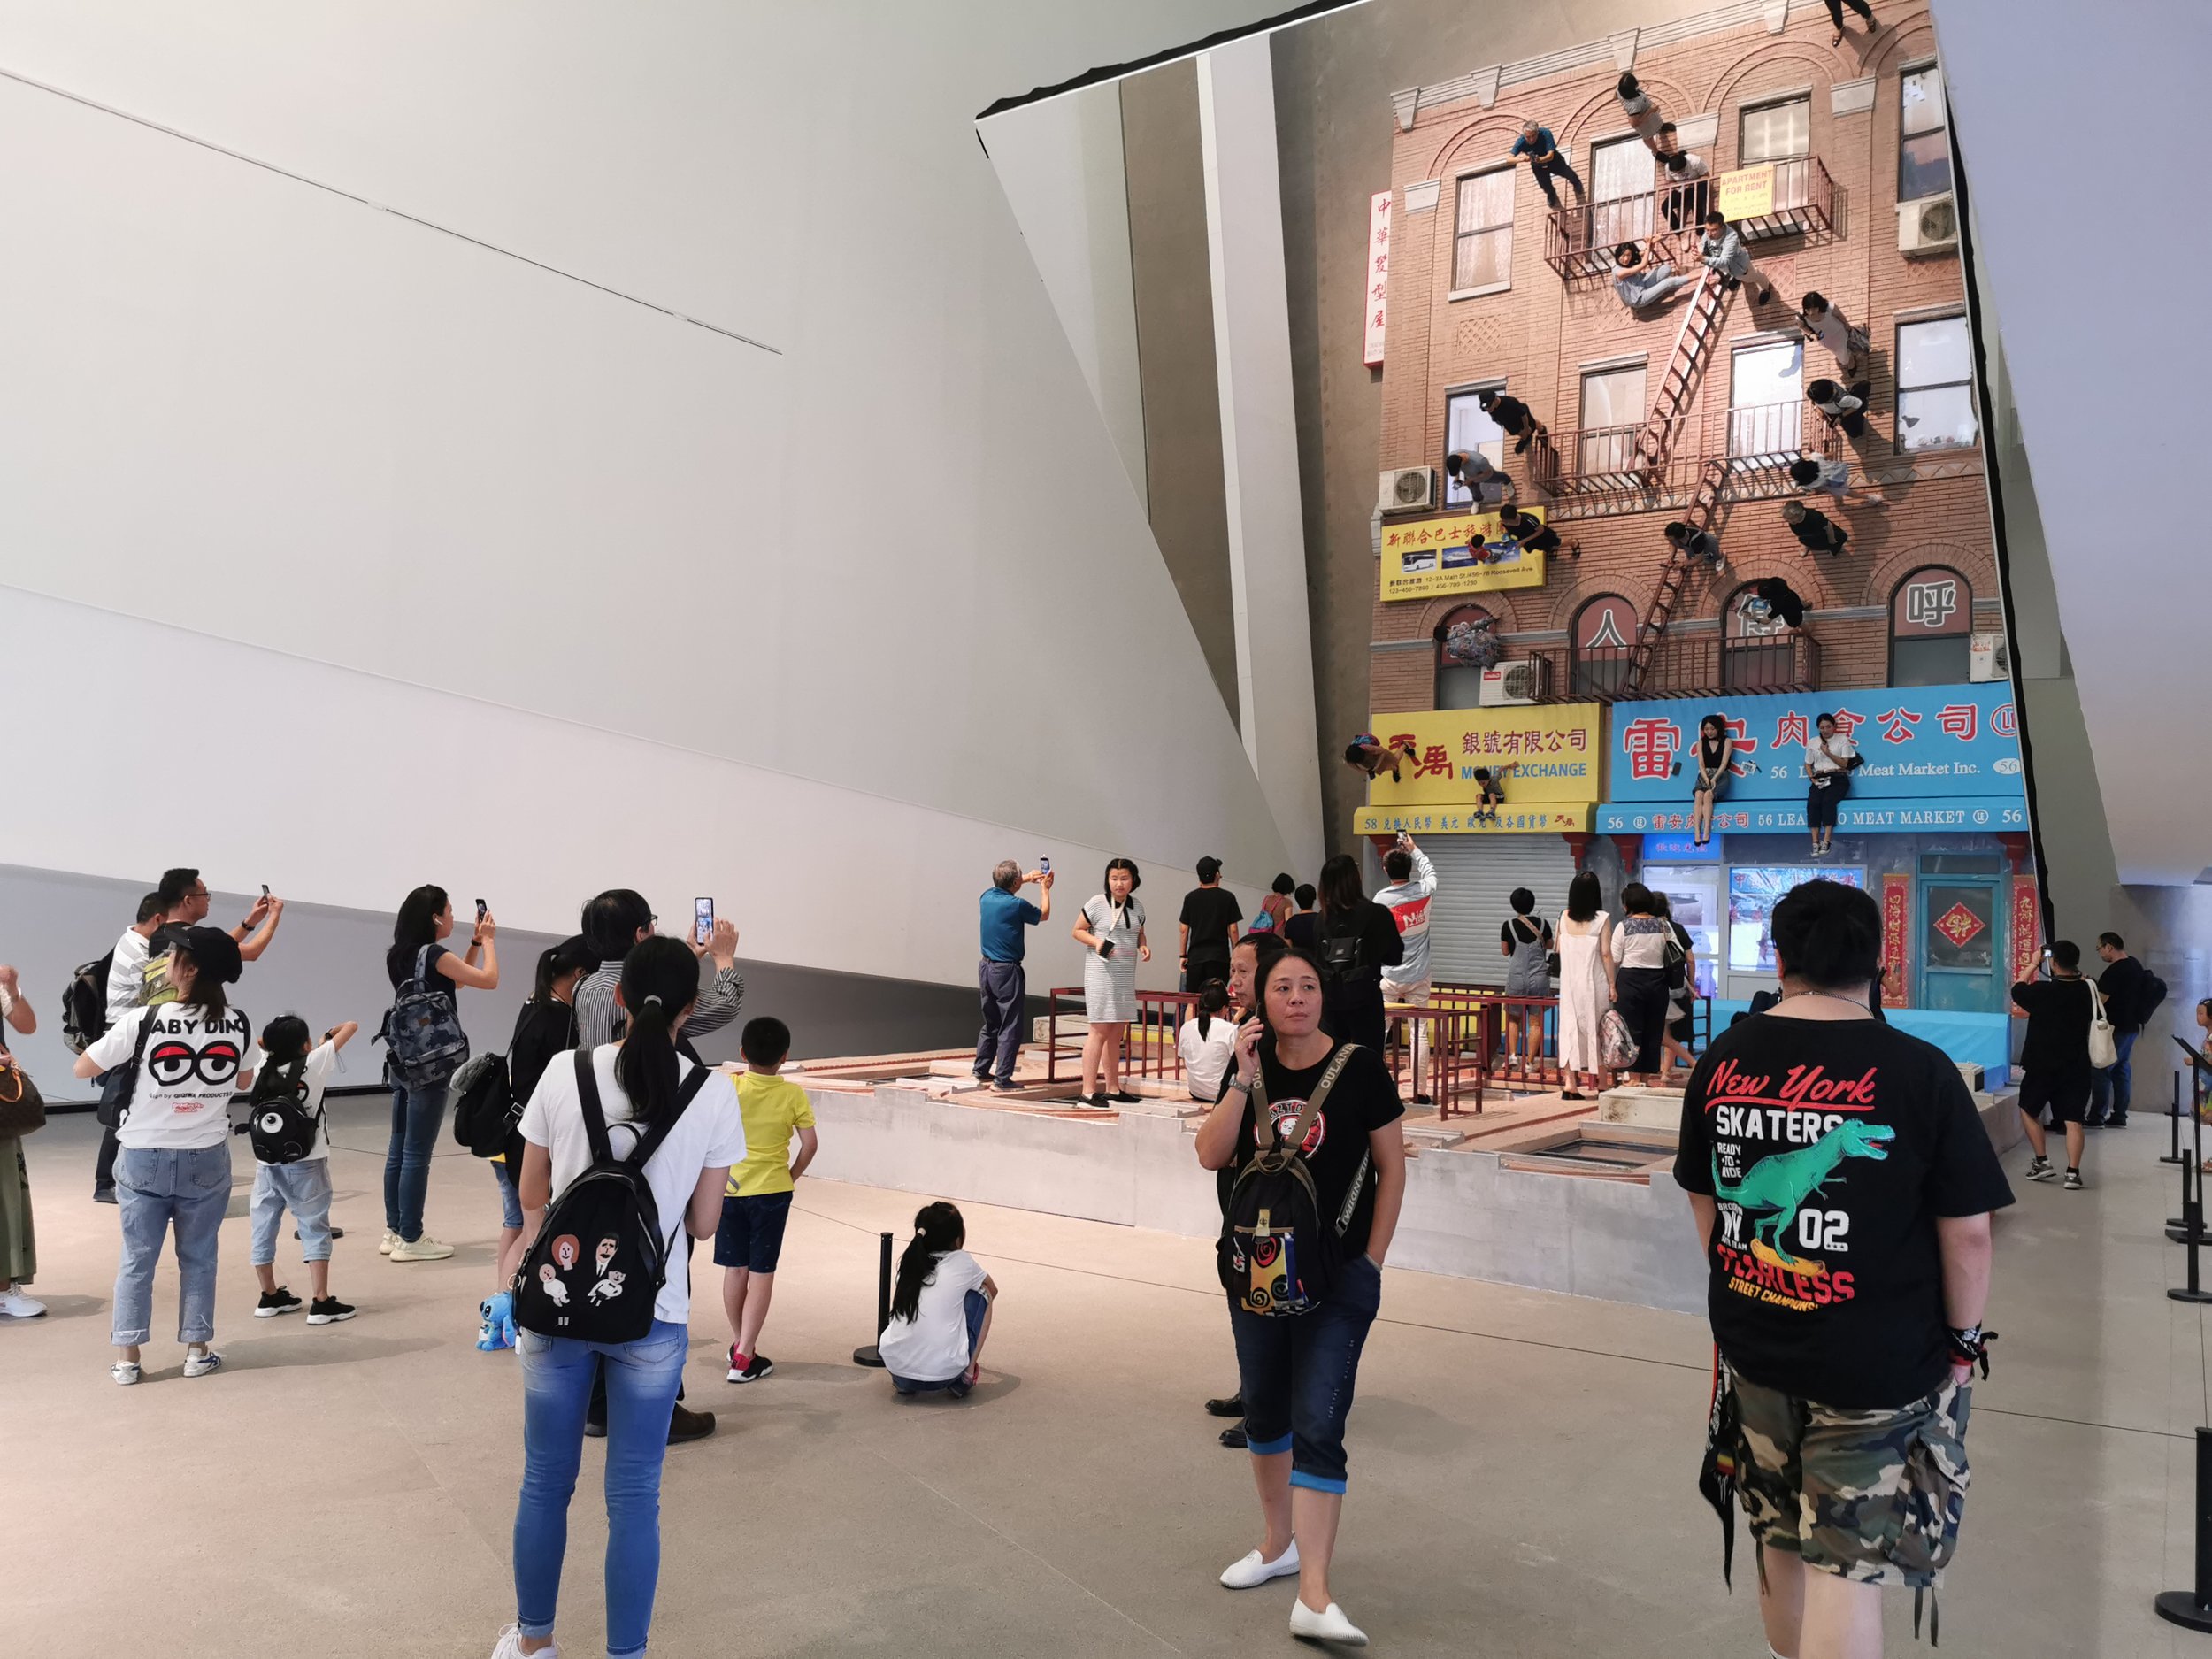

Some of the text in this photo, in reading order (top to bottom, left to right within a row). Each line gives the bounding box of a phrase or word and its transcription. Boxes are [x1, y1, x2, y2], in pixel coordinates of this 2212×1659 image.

[1722, 170, 1773, 186] APARTMENT
[1726, 180, 1767, 195] FOR RENT
[1491, 567, 1520, 576] Roosevelt
[1906, 580, 1956, 627] 呼
[1586, 609, 1627, 650] 人
[1462, 728, 1587, 756] 銀號有限公司
[1513, 763, 1586, 779] EXCHANGE
[1770, 766, 1787, 779] 56
[1859, 764, 1894, 777] Meat
[1898, 762, 1950, 776] Market
[1954, 761, 1980, 774] Inc.
[1999, 761, 2017, 772] 56
[1364, 818, 1377, 829] 58
[1608, 816, 1624, 829] 56
[1758, 814, 1773, 826] 56
[1853, 811, 1895, 825] MEAT
[1900, 810, 1965, 825] MARKET
[2002, 810, 2023, 823] 56
[150, 1018, 198, 1034] ABY
[1706, 1058, 1878, 1112] New York
[1717, 1142, 1741, 1156] READY
[1722, 1166, 1742, 1179] RIDE
[1798, 1208, 1850, 1252] 02
[1728, 1277, 1762, 1298] STREET
